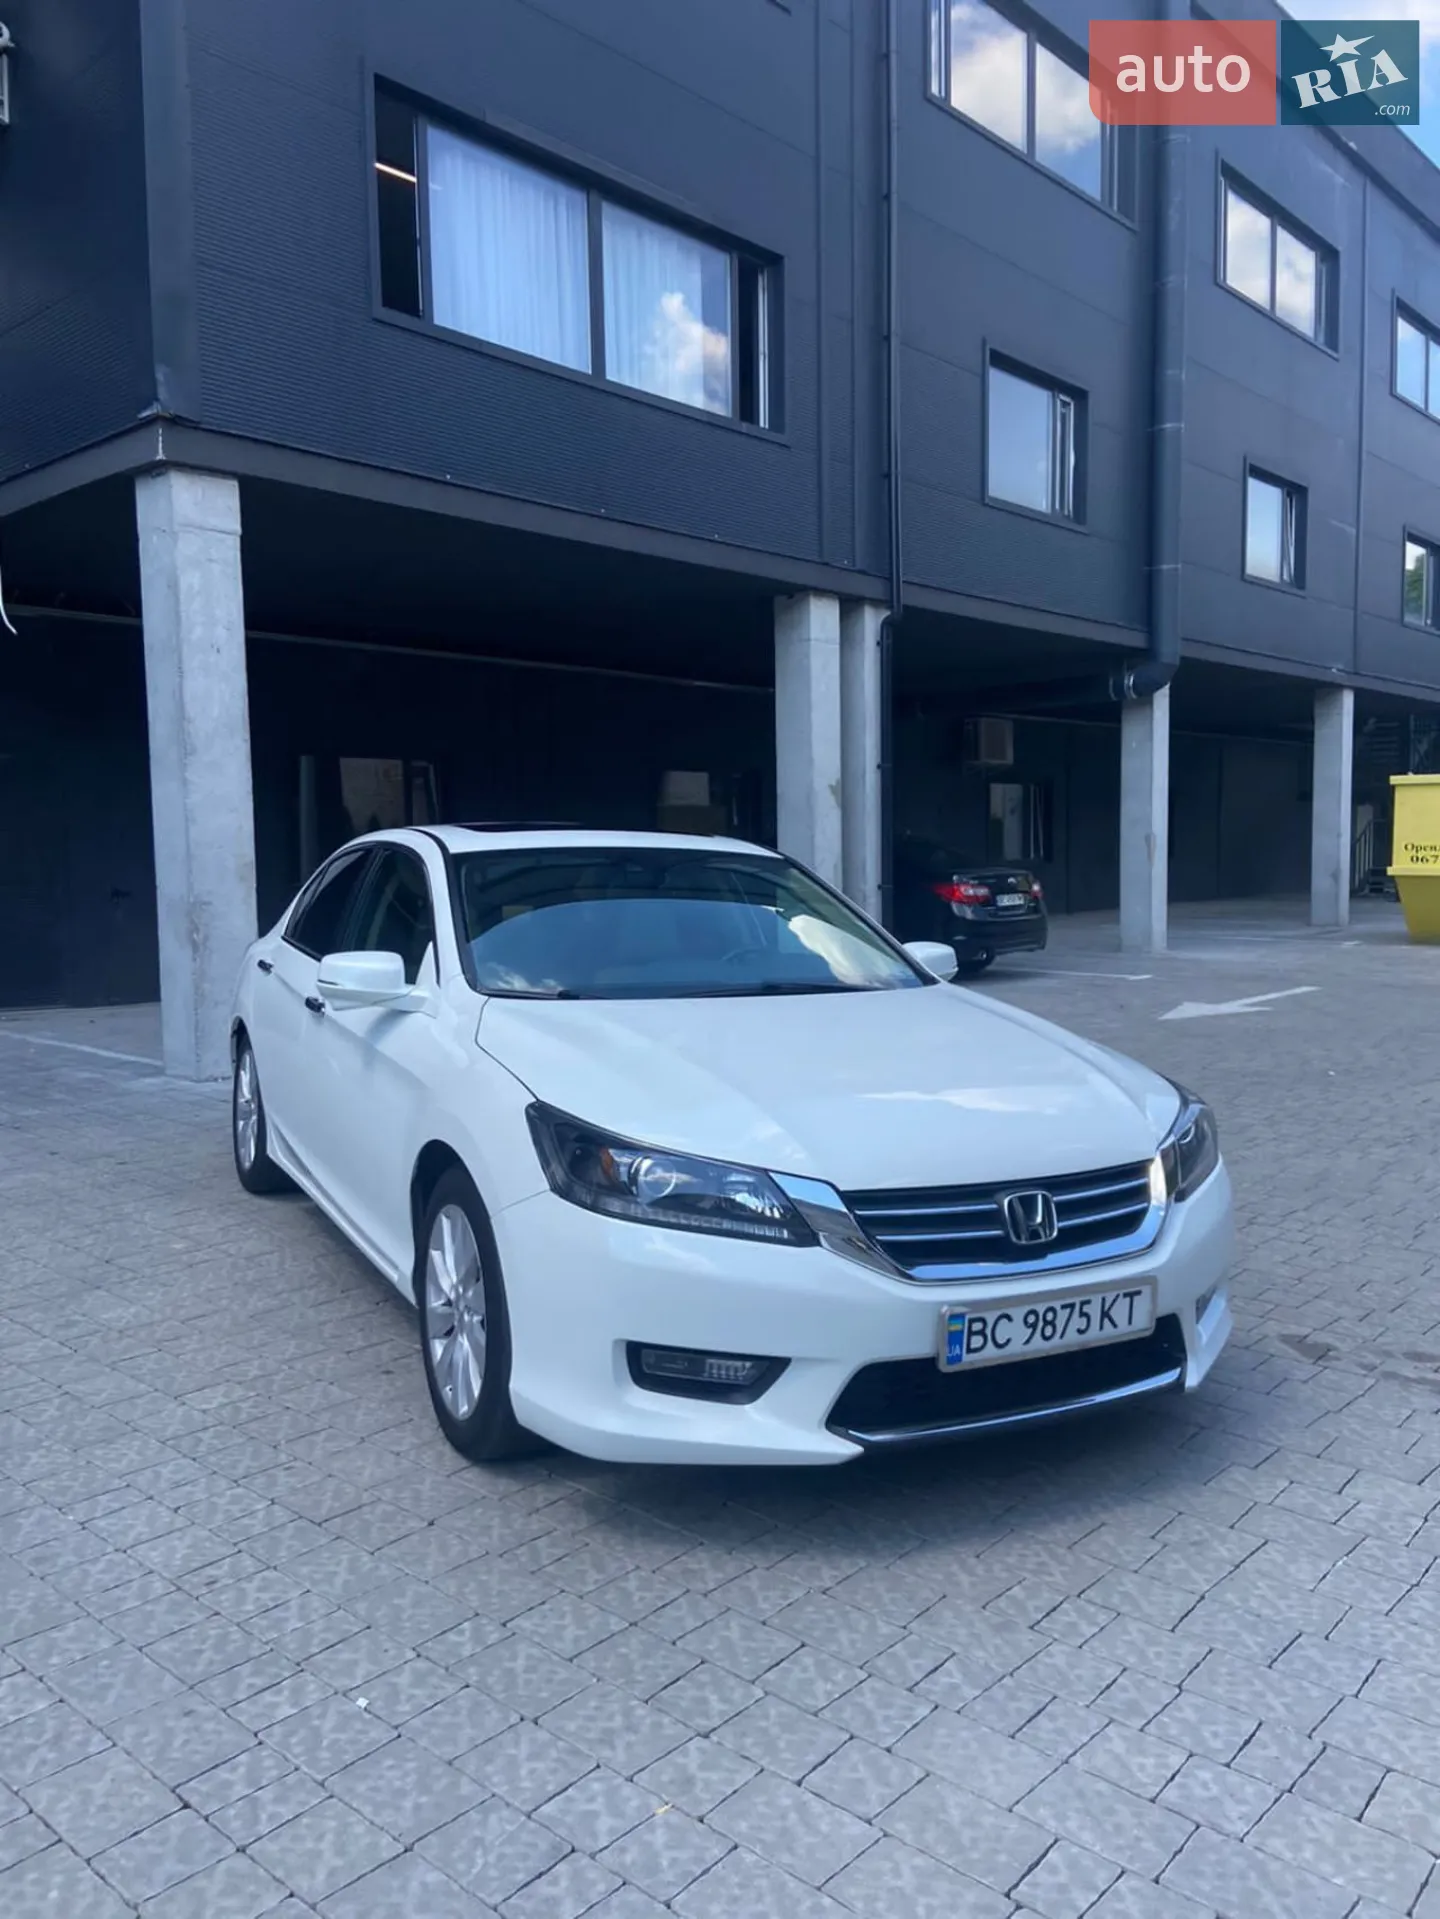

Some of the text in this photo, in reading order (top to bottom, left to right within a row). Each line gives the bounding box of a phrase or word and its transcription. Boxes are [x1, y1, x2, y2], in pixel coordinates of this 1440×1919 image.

[1404, 843, 1440, 854] Орен
[965, 1289, 1142, 1354] BC 9875 KT
